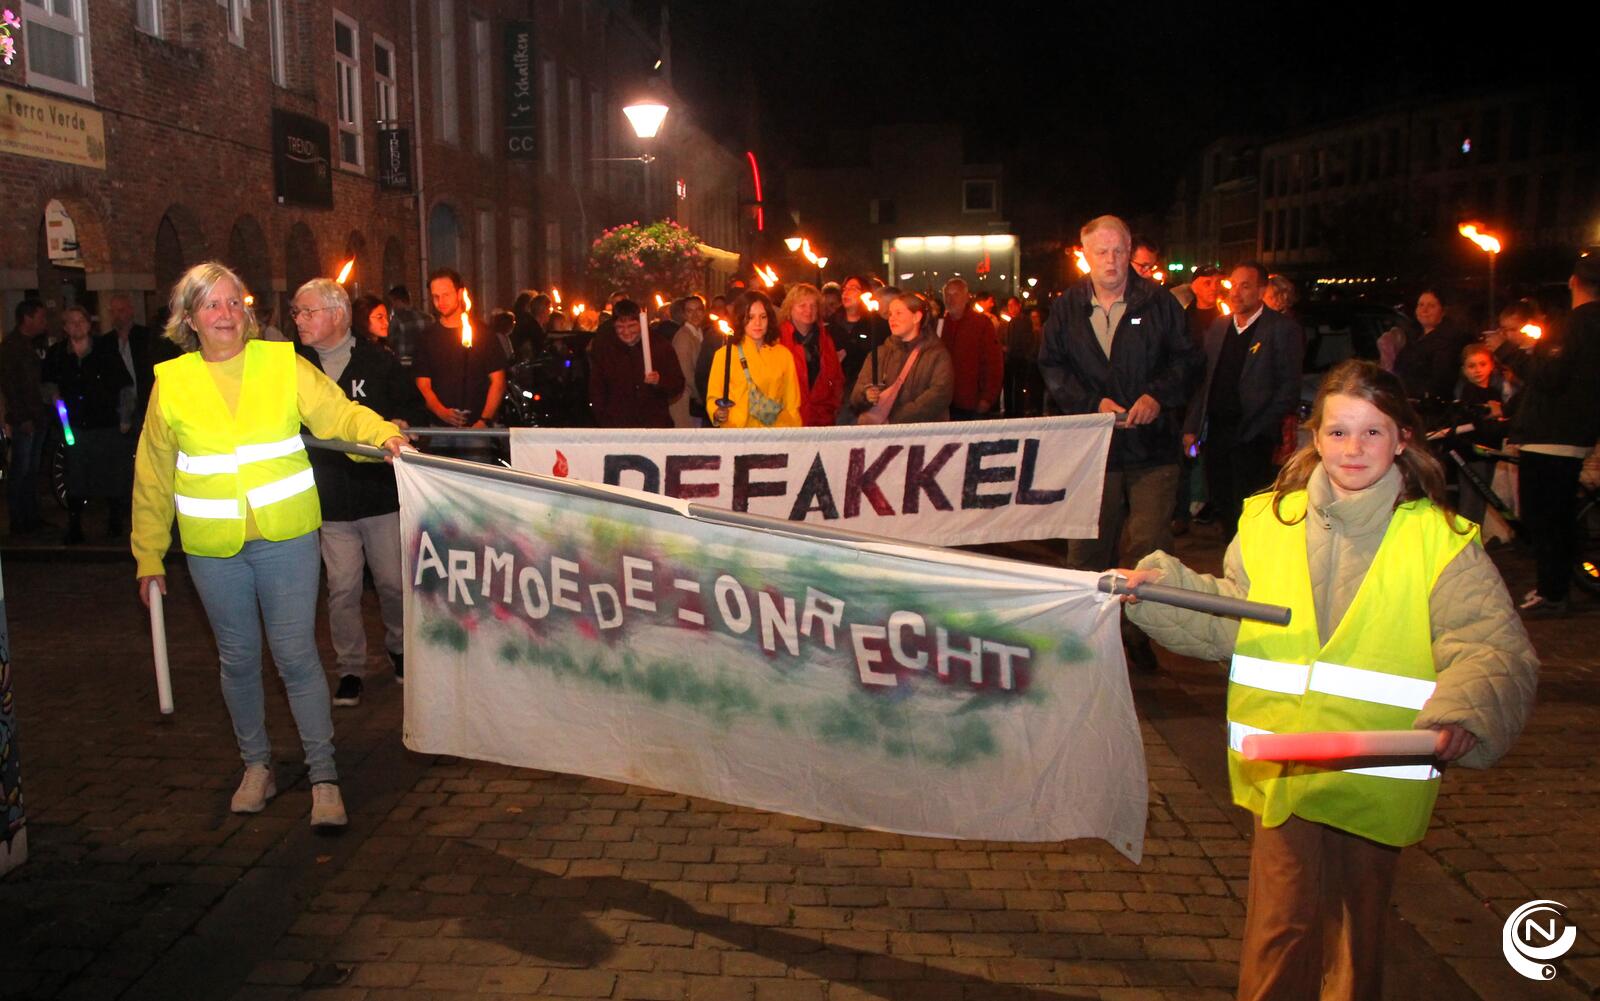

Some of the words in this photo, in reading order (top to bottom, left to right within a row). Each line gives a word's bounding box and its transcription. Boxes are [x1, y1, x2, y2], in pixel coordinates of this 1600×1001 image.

[6, 94, 44, 122] Terra
[48, 105, 86, 131] Verde
[508, 136, 535, 152] CC
[351, 379, 367, 398] K
[414, 531, 657, 630] ARMOEDE
[714, 574, 1032, 690] ONRECHT
